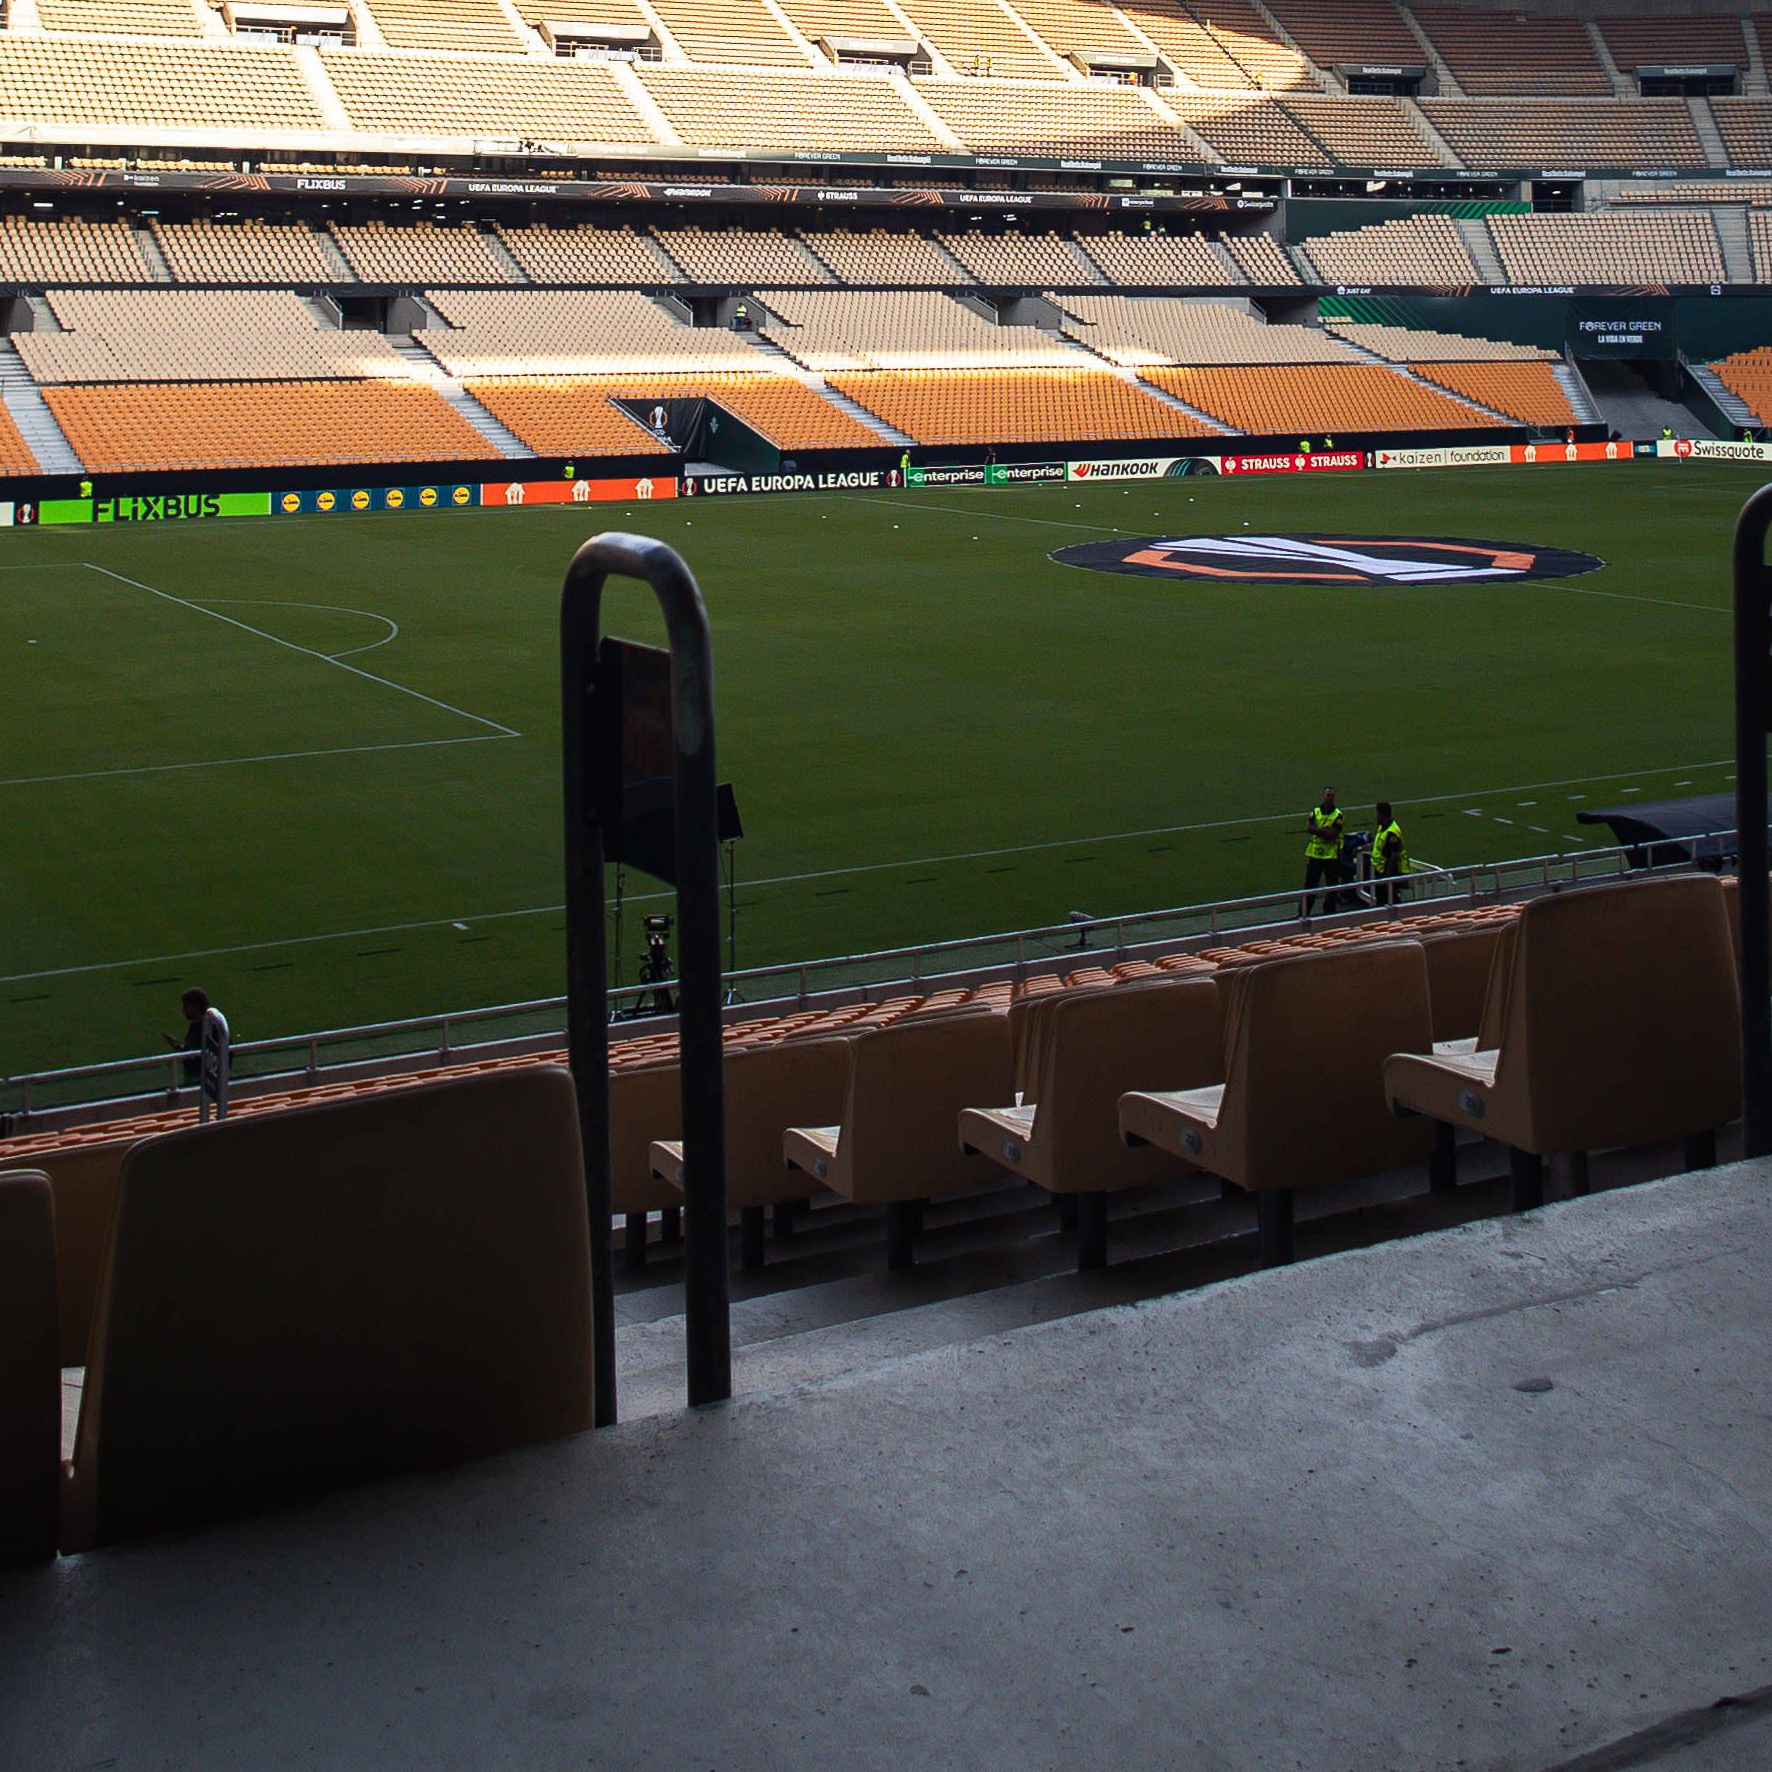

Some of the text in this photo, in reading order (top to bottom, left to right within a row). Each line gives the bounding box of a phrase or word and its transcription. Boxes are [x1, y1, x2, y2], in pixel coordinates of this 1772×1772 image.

[491, 184, 524, 192] EUROPA
[525, 185, 556, 193] LEAGUE
[826, 192, 858, 200] STRAUSS
[959, 194, 1032, 203] UEFA EUROPA LEAGUE
[1579, 321, 1661, 331] FOREVER GREEN
[1399, 450, 1504, 464] kaizen foundation
[1694, 441, 1764, 459] Swissquote
[1242, 455, 1357, 470] STRAUSS STRAUSS
[912, 465, 1064, 483] enterprise enterprise
[703, 472, 880, 493] UEFA EUROPA LEAGUE
